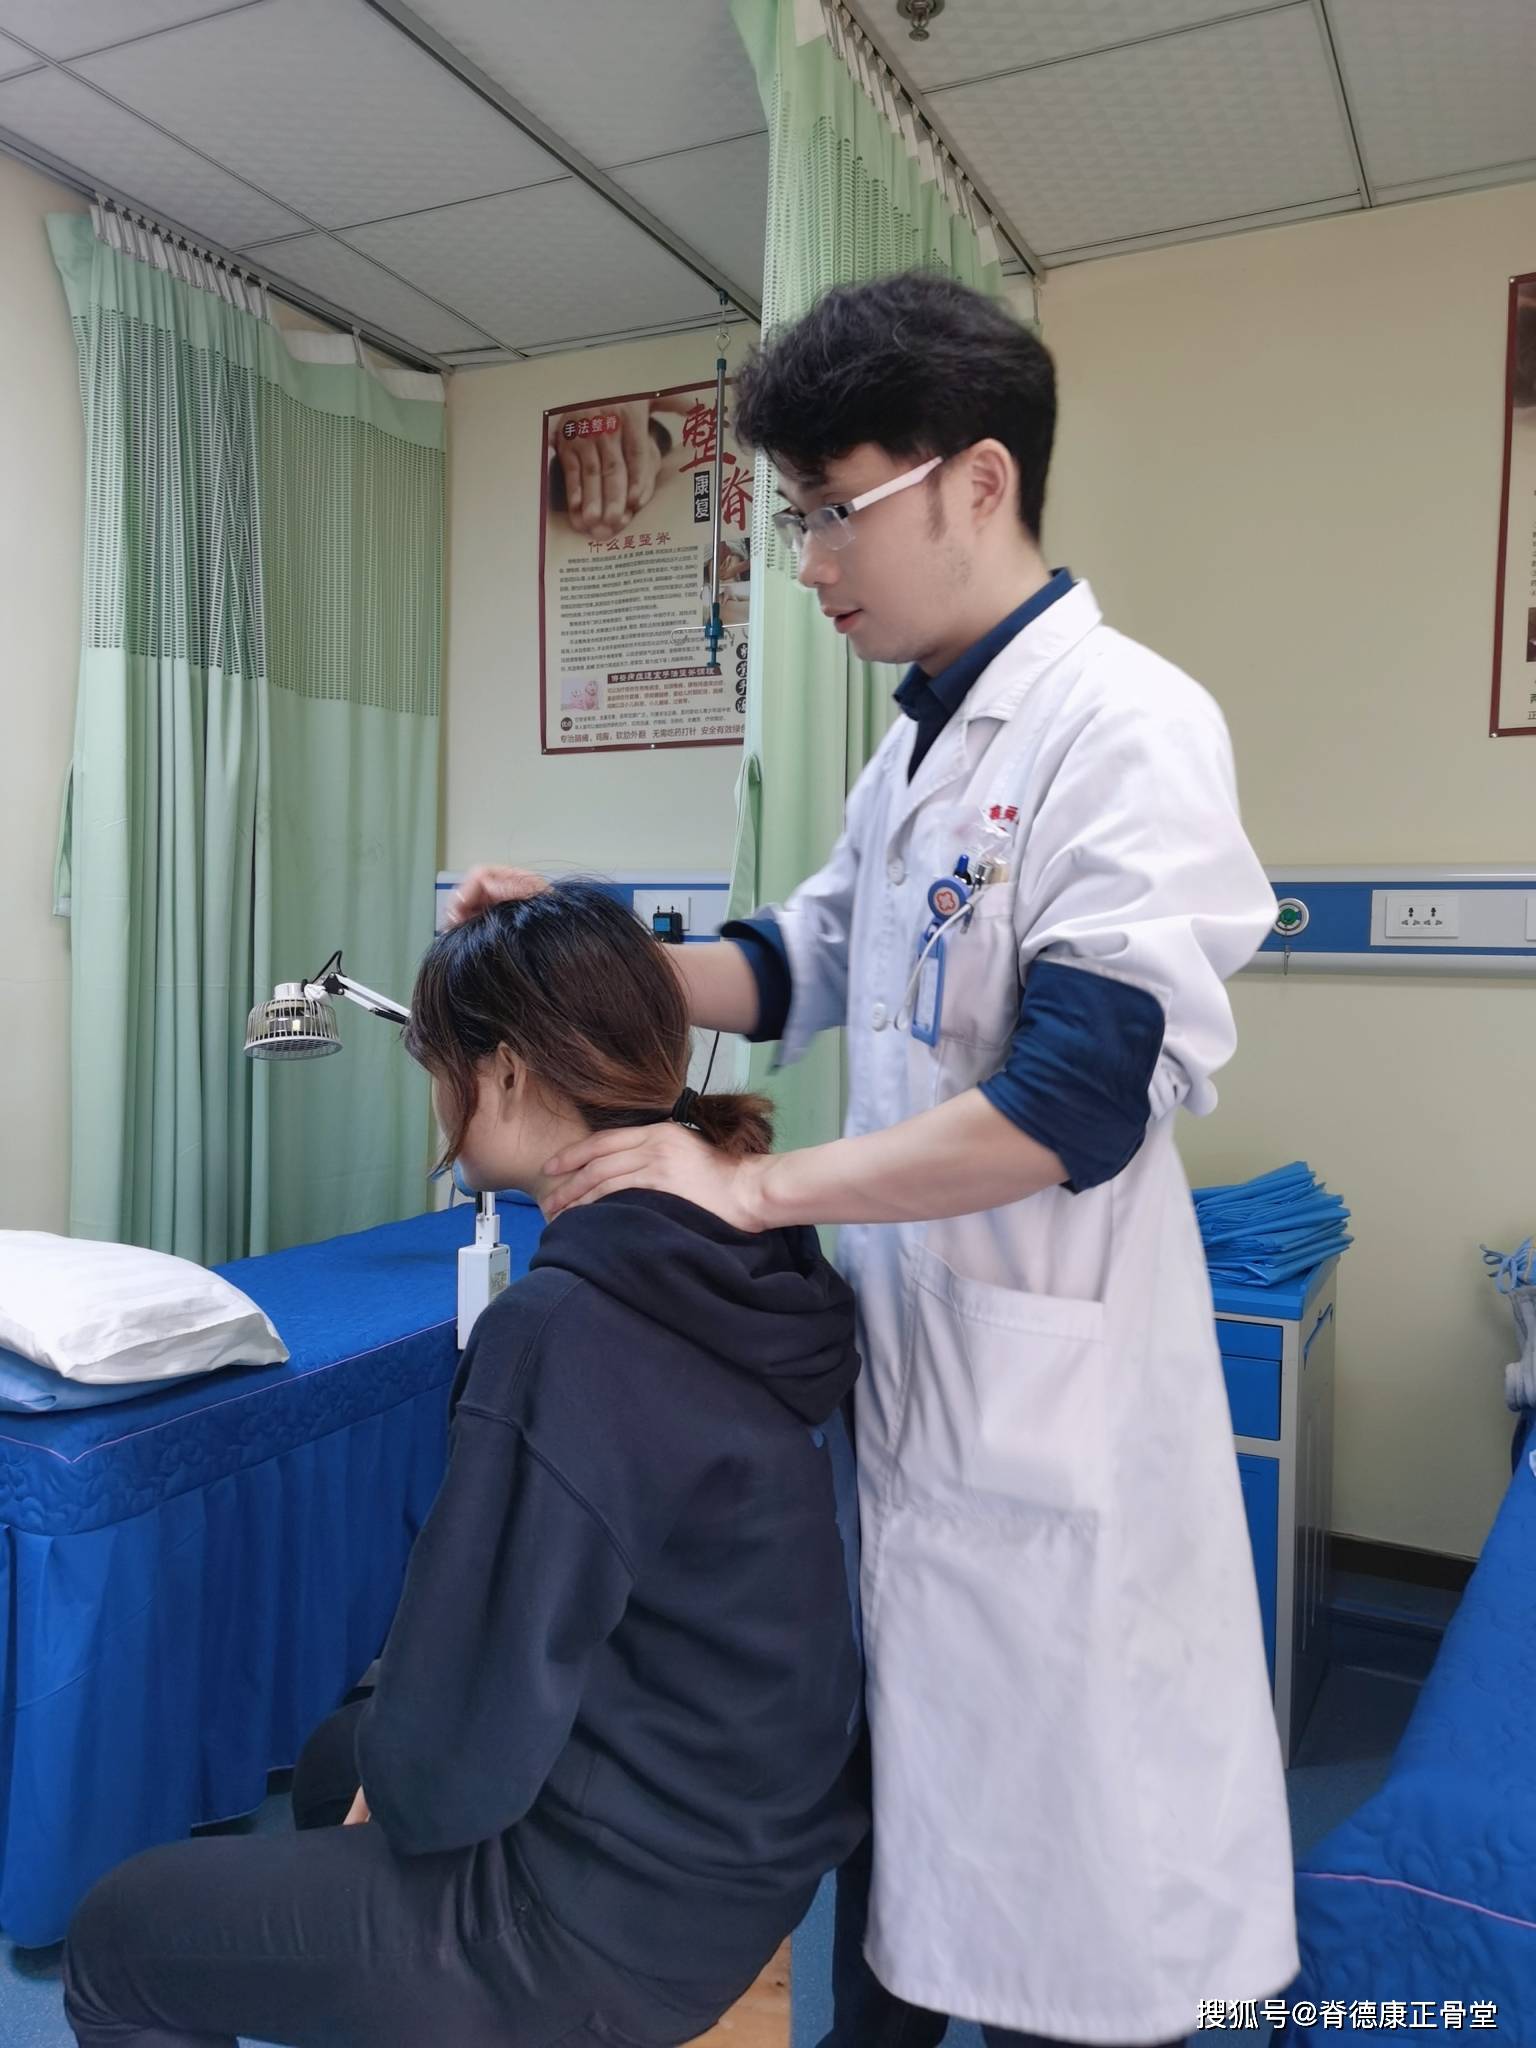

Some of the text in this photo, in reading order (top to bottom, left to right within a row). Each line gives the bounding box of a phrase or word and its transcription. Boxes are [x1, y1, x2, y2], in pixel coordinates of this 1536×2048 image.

[564, 415, 617, 437] 手法整脊
[694, 474, 709, 518] 康复
[588, 531, 671, 553] 什么是整脊
